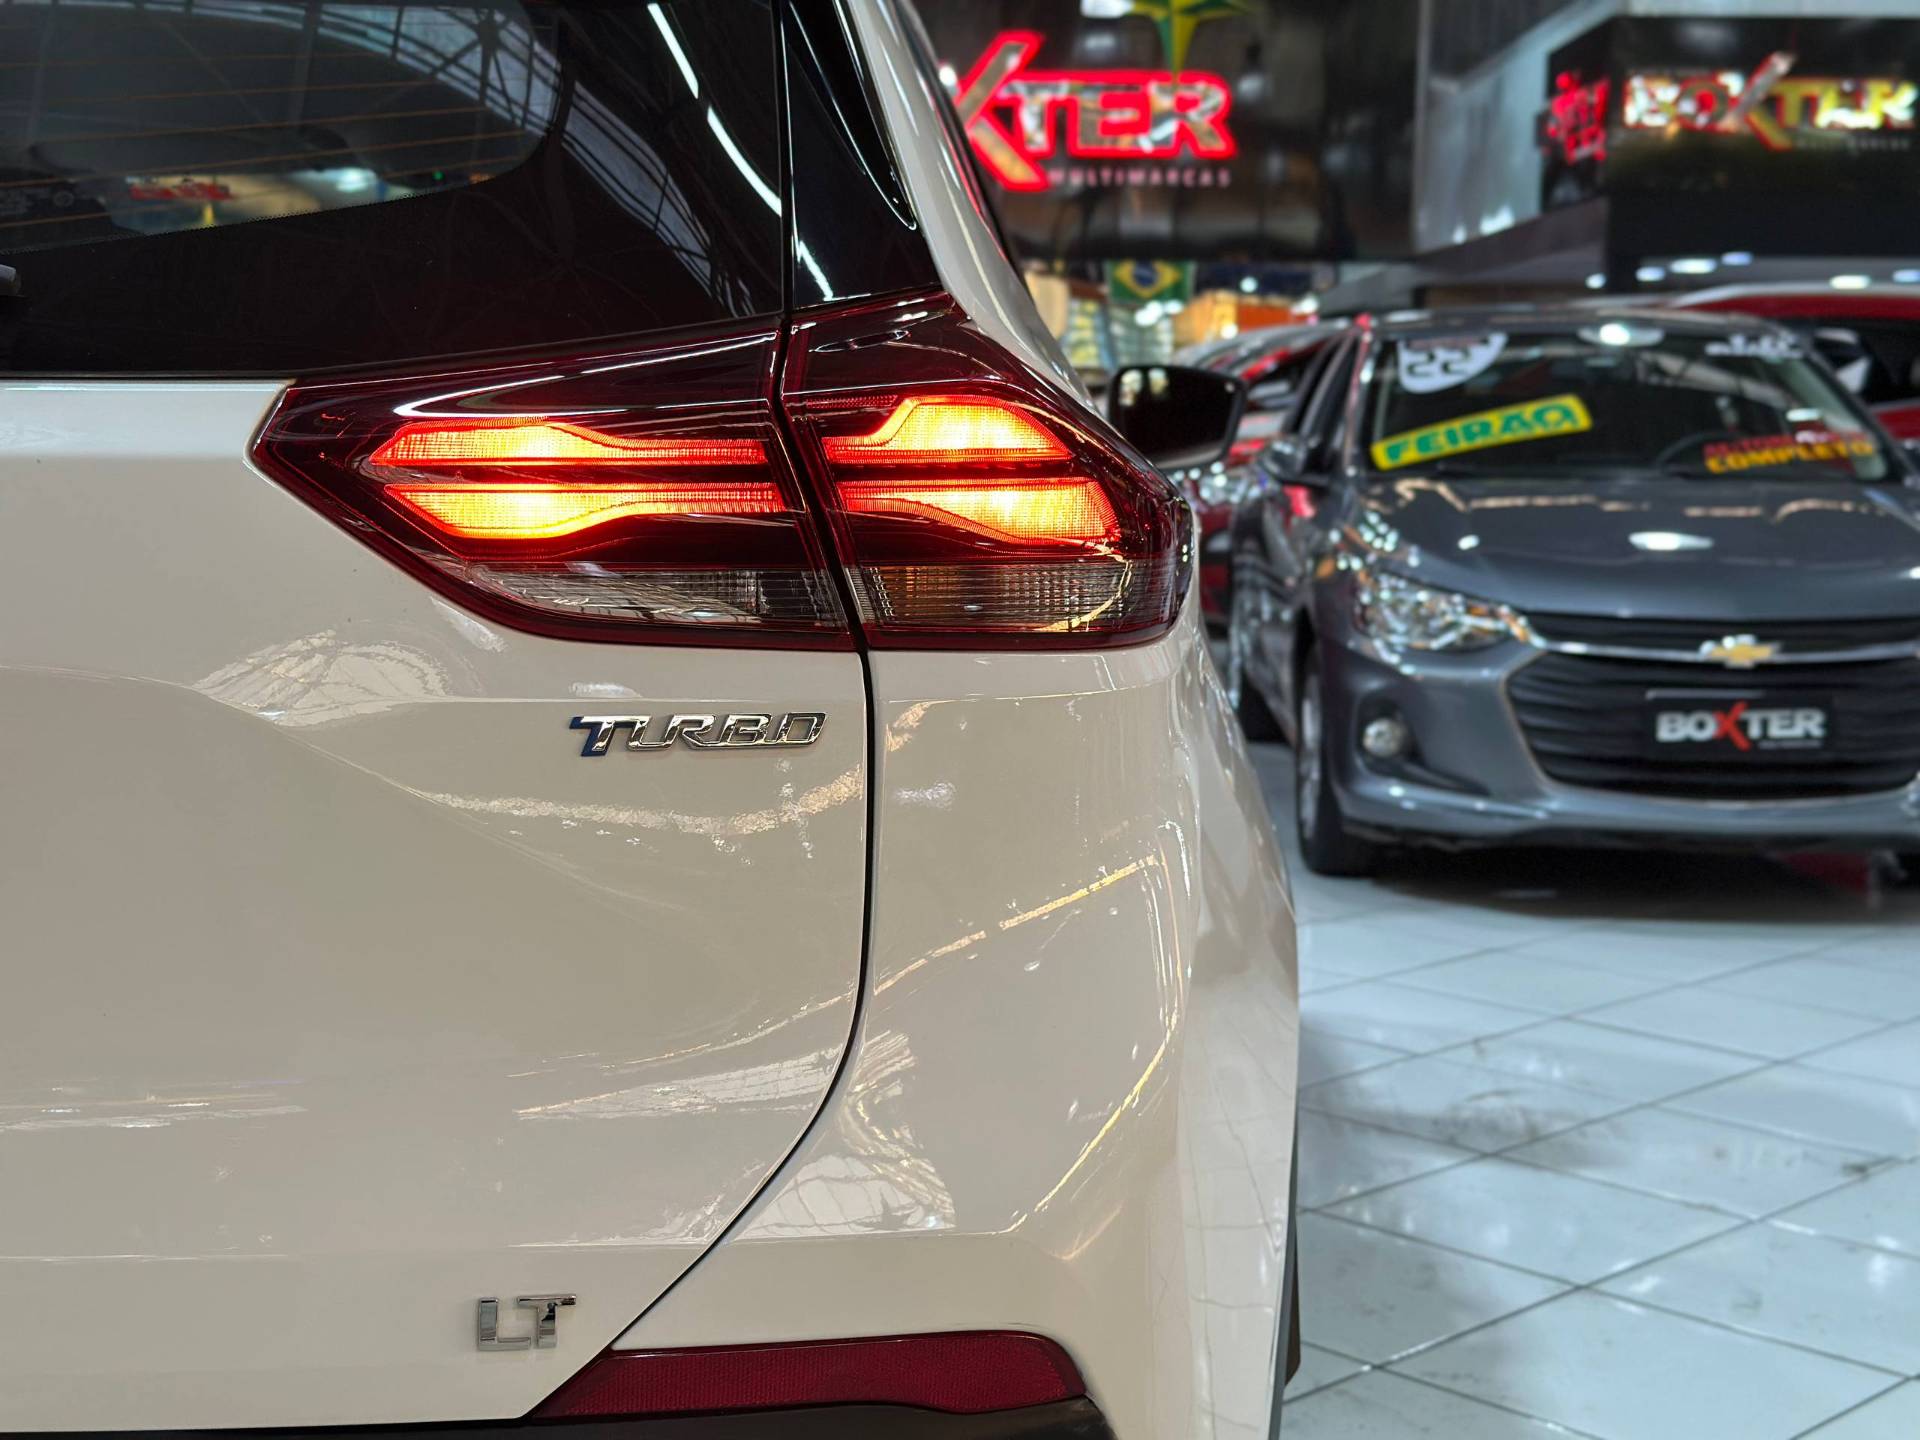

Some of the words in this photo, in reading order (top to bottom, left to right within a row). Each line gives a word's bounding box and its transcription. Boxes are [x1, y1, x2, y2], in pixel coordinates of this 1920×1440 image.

[1048, 167, 1231, 187] MULTIMARCAS
[569, 711, 828, 757] TURBO
[1655, 700, 1827, 751] BOXTER
[477, 1293, 577, 1351] LT
